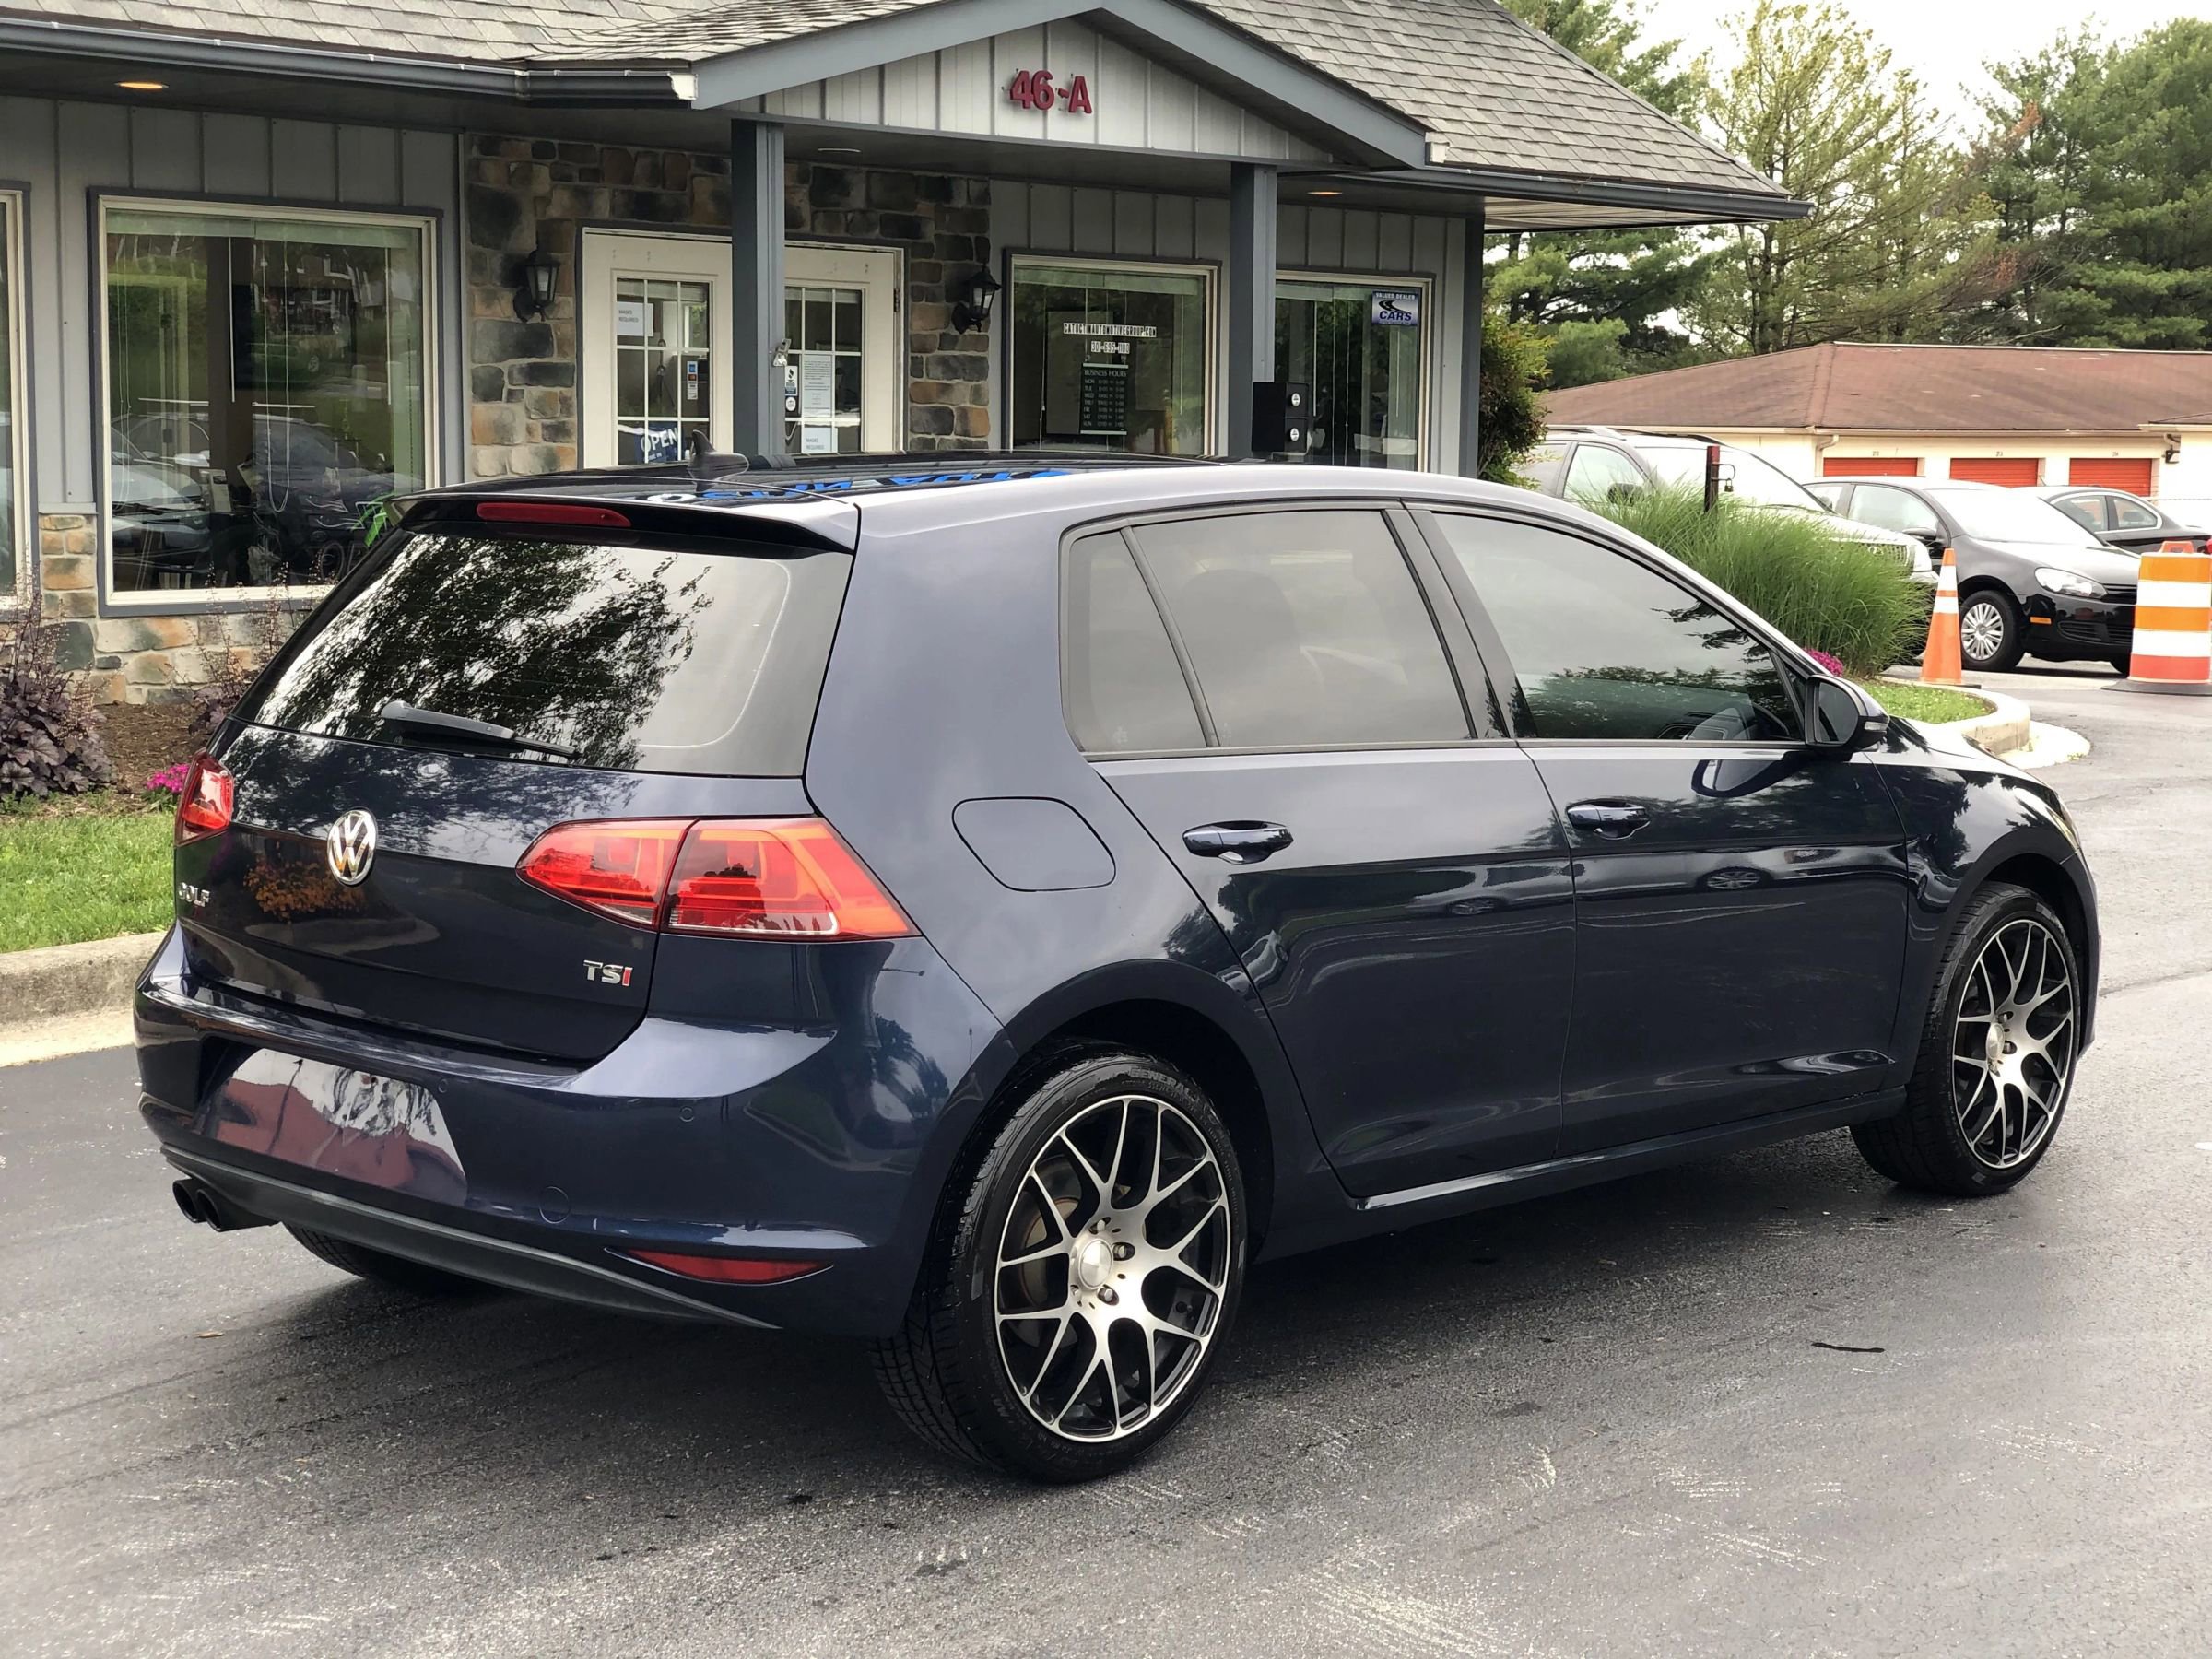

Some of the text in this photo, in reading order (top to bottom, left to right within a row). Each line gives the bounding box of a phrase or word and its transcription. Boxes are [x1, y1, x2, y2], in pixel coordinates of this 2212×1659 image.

[1010, 70, 1092, 113] 46-A
[1379, 311, 1412, 321] CARS
[640, 427, 677, 452] OPEN
[328, 811, 376, 884] VW
[583, 959, 633, 986] TSI
